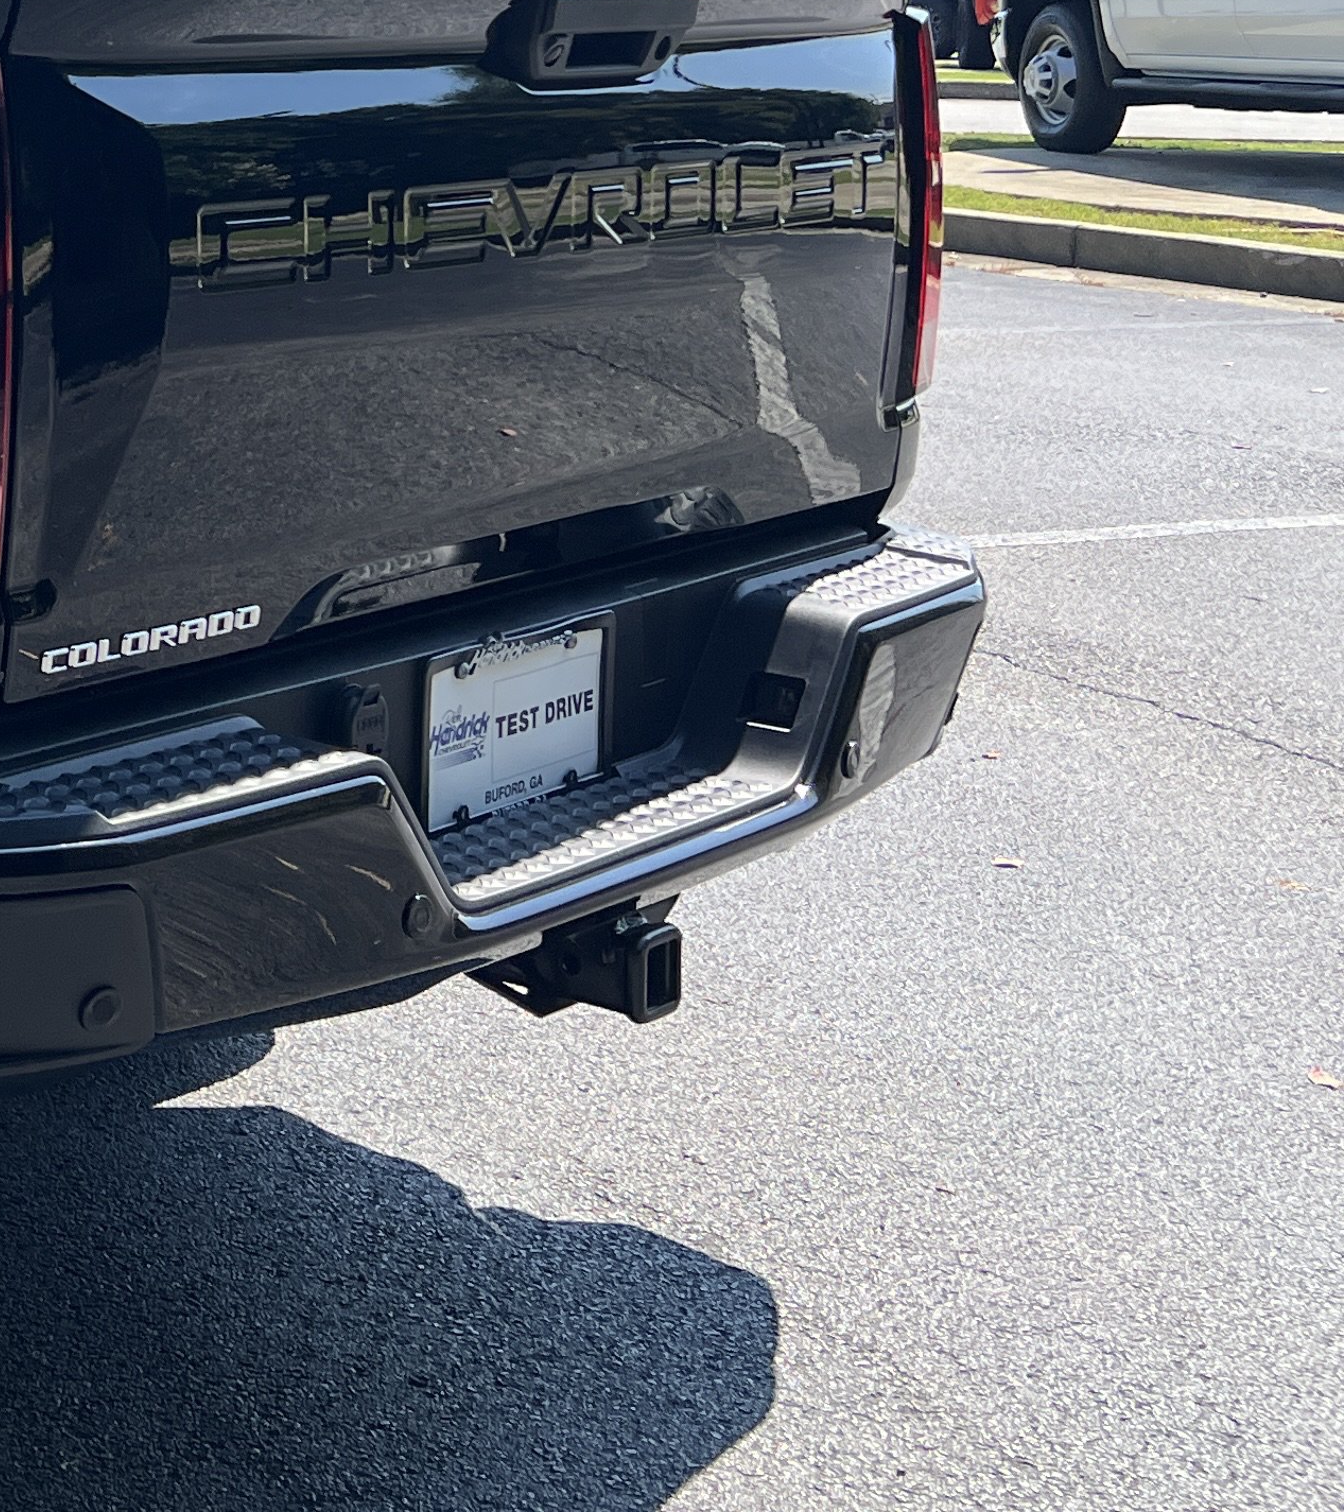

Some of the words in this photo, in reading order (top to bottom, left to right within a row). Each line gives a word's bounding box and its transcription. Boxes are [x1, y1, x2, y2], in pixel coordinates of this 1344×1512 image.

[196, 140, 885, 294] CHEVROLET
[40, 604, 262, 675] COLORADO
[430, 711, 490, 756] Hendrick
[495, 706, 539, 738] TEST
[545, 689, 594, 724] DRIVE
[485, 780, 527, 805] BUFORD,
[529, 774, 544, 789] GA
